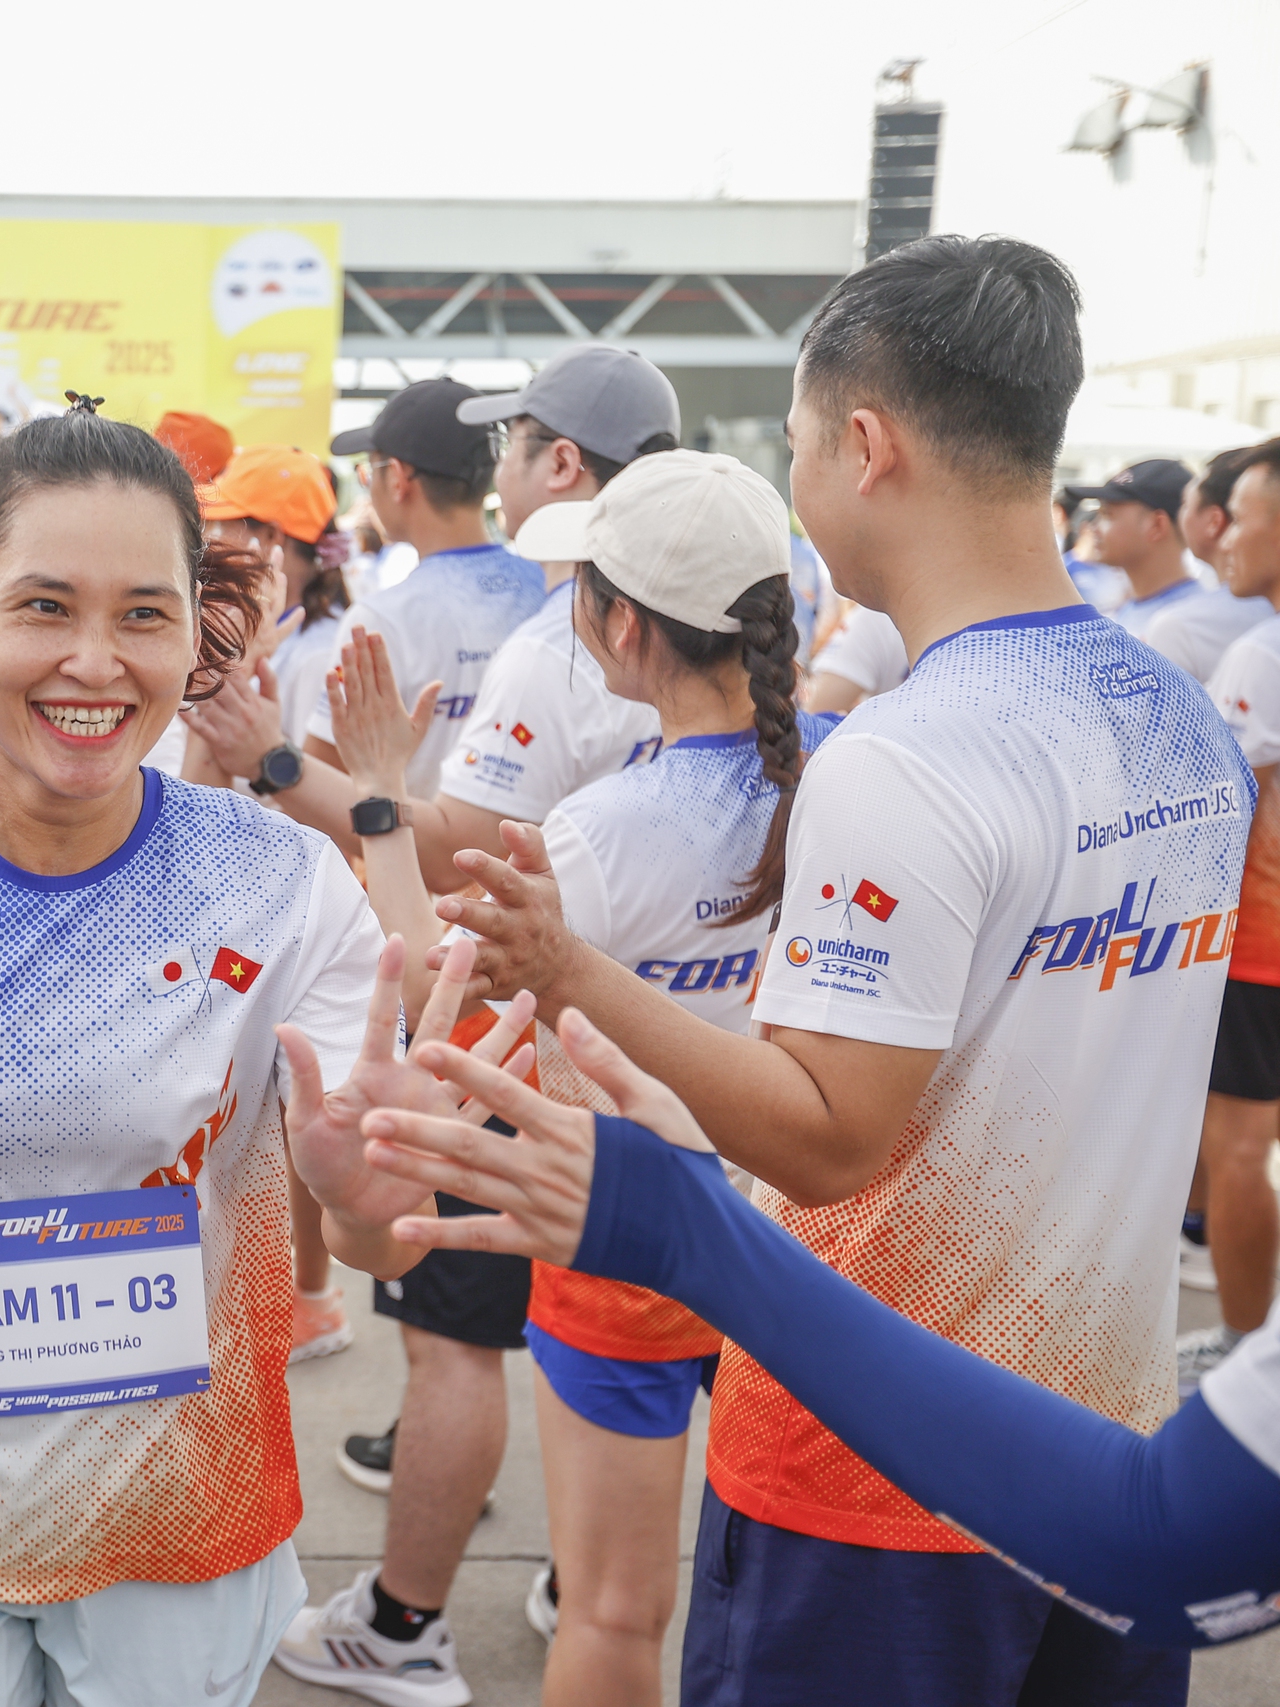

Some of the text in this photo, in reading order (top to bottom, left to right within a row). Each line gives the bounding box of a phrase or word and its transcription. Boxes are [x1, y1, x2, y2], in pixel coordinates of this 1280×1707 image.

[104, 340, 175, 376] 2025
[1105, 664, 1132, 681] Viet
[1110, 674, 1159, 697] Running
[1077, 821, 1118, 853] Diana
[1007, 875, 1158, 981] FOR U
[817, 938, 890, 966] unicharm
[811, 978, 828, 988] Diana
[829, 980, 865, 995] Unicharm
[37, 1214, 185, 1244] FUTURE 2025
[43, 1207, 68, 1227] U
[50, 1282, 82, 1321] 11
[127, 1273, 178, 1313] 03
[8, 1348, 33, 1364] THỊ
[37, 1341, 100, 1359] PHƯƠNG
[103, 1334, 142, 1352] THẢO
[47, 1384, 160, 1409] POSSIBILITIES
